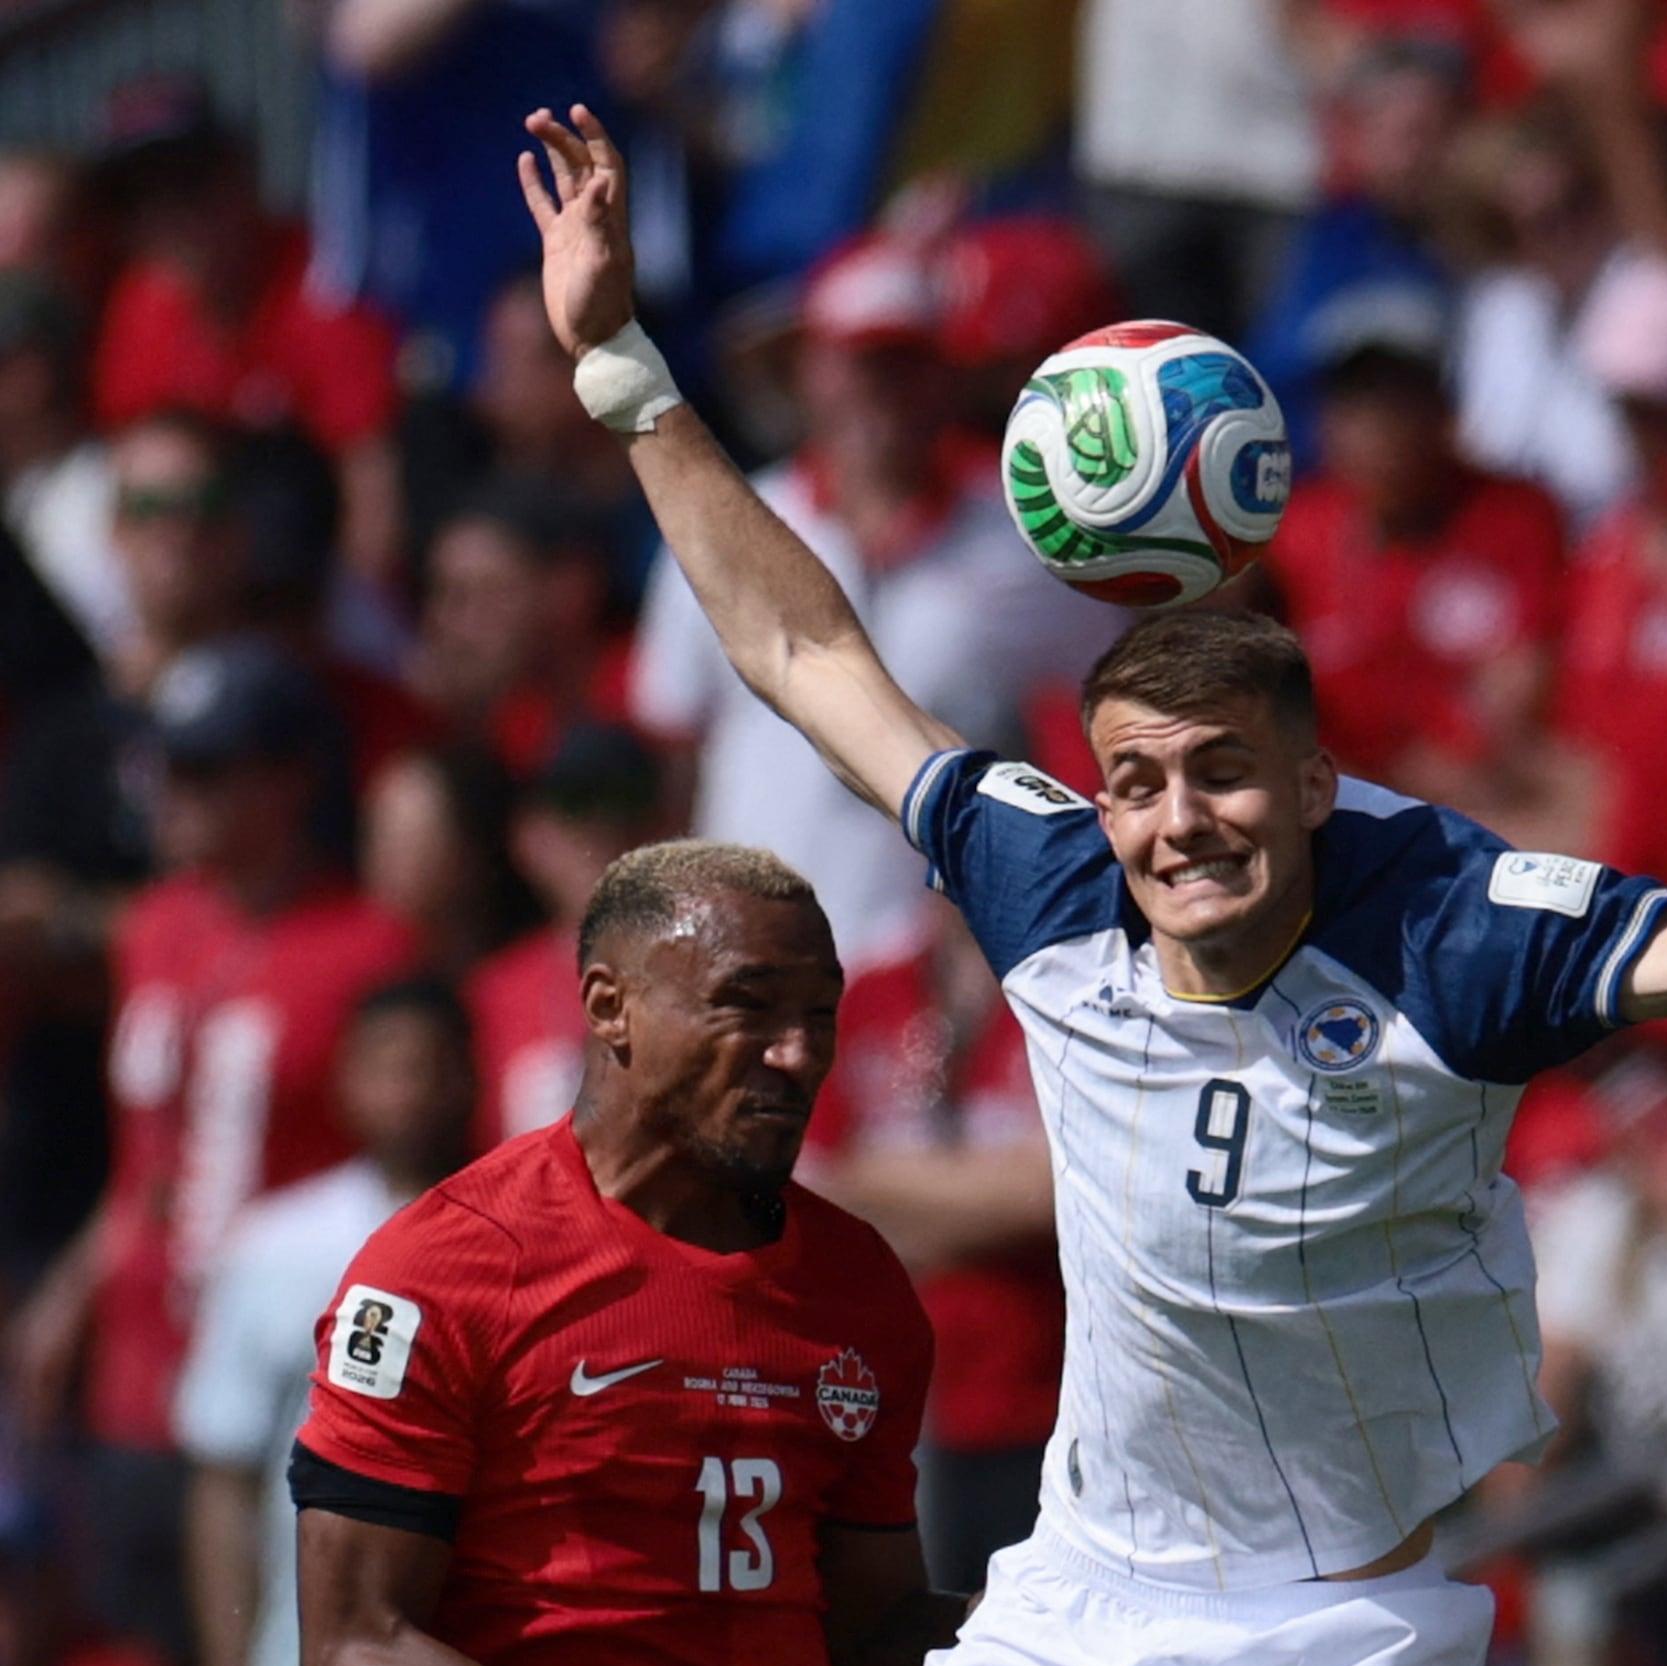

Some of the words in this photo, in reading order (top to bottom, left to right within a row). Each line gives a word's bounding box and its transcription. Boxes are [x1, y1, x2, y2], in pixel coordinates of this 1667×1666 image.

[1185, 1077, 1252, 1208] 9
[819, 1387, 878, 1407] CANADA
[695, 1456, 782, 1592] 13
